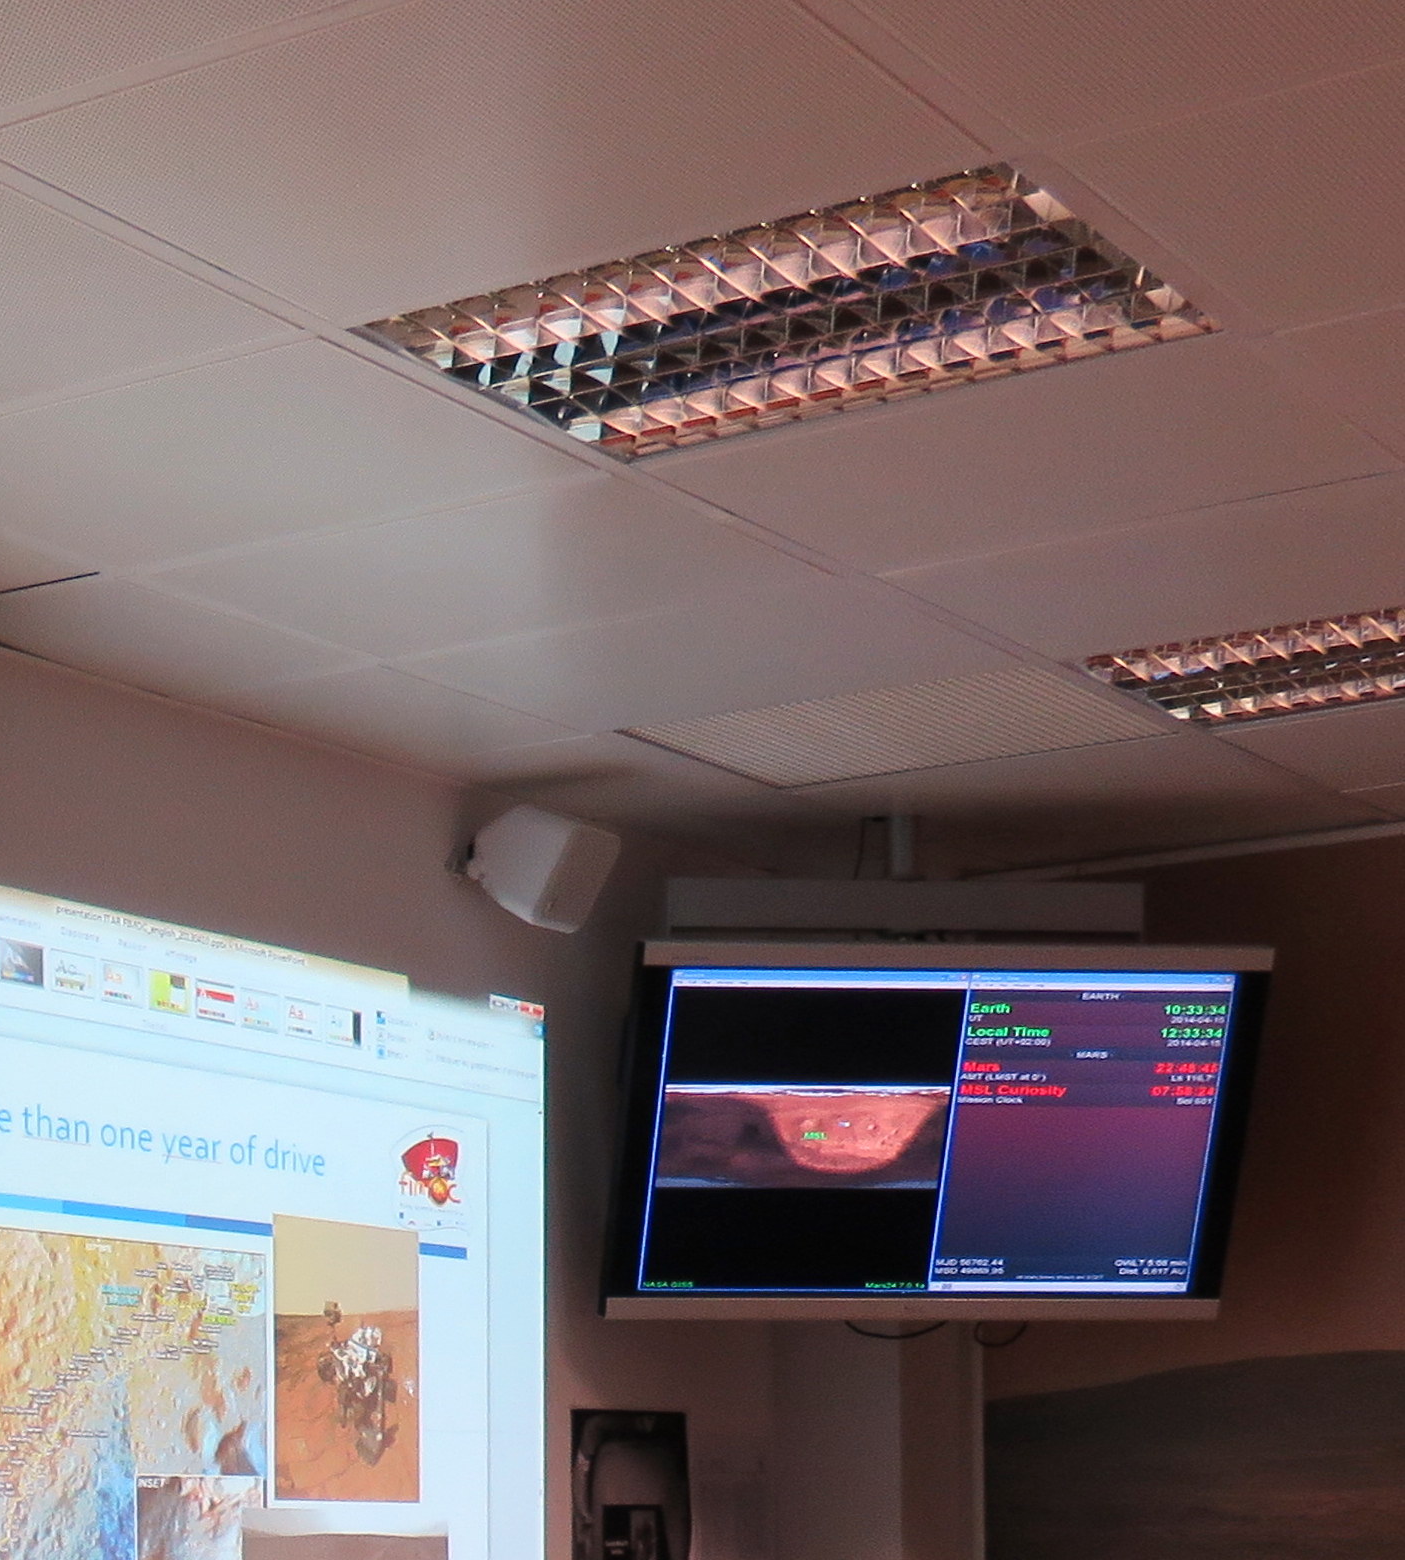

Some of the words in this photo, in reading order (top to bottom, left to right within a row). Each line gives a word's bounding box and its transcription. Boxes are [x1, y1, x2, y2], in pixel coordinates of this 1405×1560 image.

[1082, 993, 1120, 1001] EARTH
[970, 1003, 1011, 1015] Earth
[1164, 1004, 1228, 1016] 10:33:34
[968, 1014, 983, 1023] UT
[967, 1026, 1008, 1038] Local
[1013, 1026, 1051, 1038] Time
[1161, 1028, 1224, 1039] 12:33:34
[964, 1037, 993, 1046] CEST
[1075, 1051, 1108, 1060] MARS
[963, 1062, 1002, 1073] Mars
[959, 1072, 984, 1082] AMT
[960, 1085, 992, 1096] MSL
[997, 1085, 1067, 1098] Curiosity
[996, 1096, 1023, 1105] Clock
[22, 1103, 90, 1145] than
[101, 1121, 153, 1152] one
[162, 1129, 222, 1165] year
[230, 1133, 257, 1166] of
[264, 1137, 326, 1177] drive
